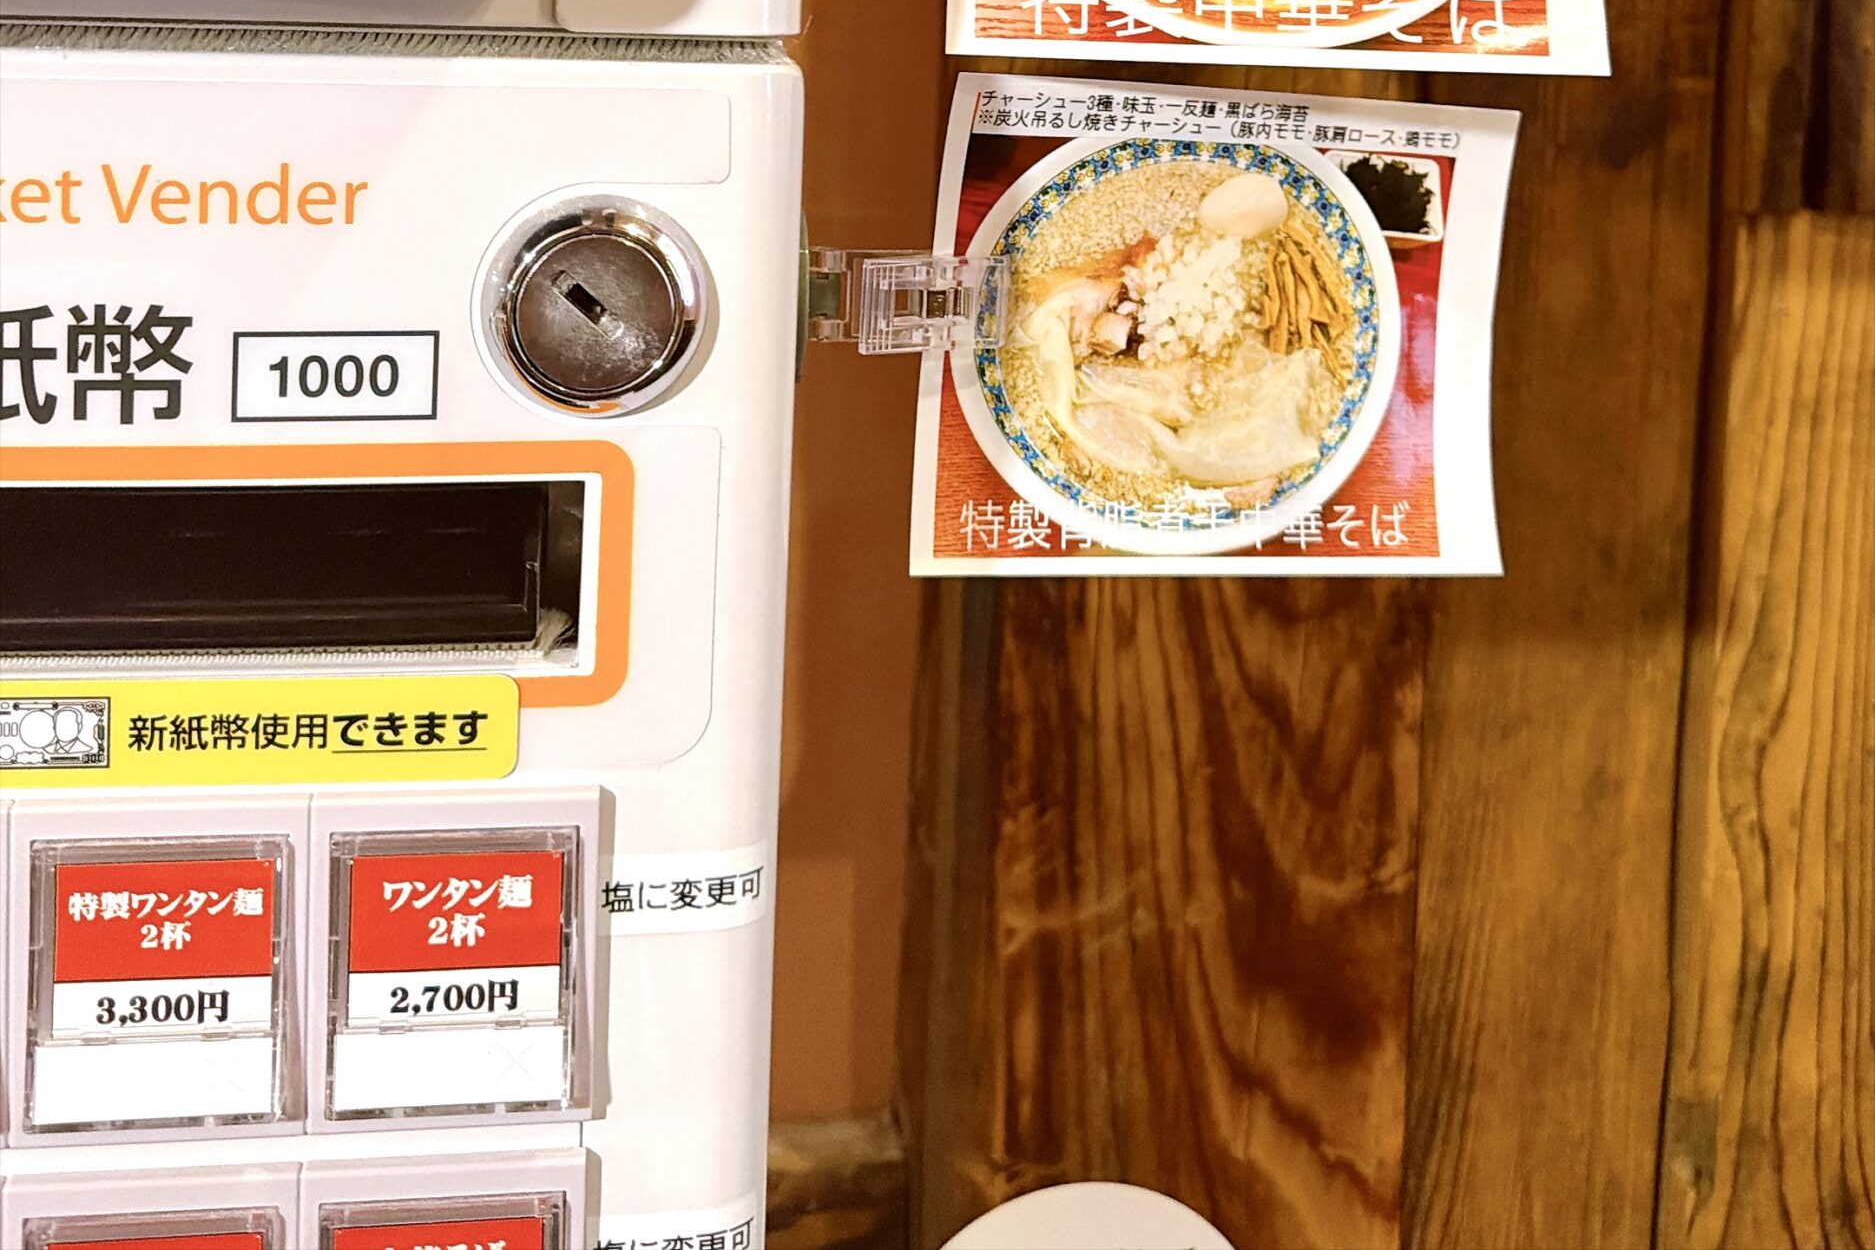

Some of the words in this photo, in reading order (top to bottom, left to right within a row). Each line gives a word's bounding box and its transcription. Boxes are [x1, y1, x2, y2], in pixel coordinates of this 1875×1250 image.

[0, 170, 82, 225] et
[101, 163, 368, 225] Vender
[268, 354, 400, 399] 1000
[128, 710, 489, 751] 新紙幣使用できます
[68, 886, 265, 922] 特製ワンタン麺
[382, 874, 535, 910] ワンタン麺
[601, 865, 764, 913] 塩に変更可
[140, 921, 192, 950] 2杯
[428, 912, 486, 947] 2杯
[96, 989, 231, 1026] 3,300円
[390, 978, 520, 1016] 2,700円
